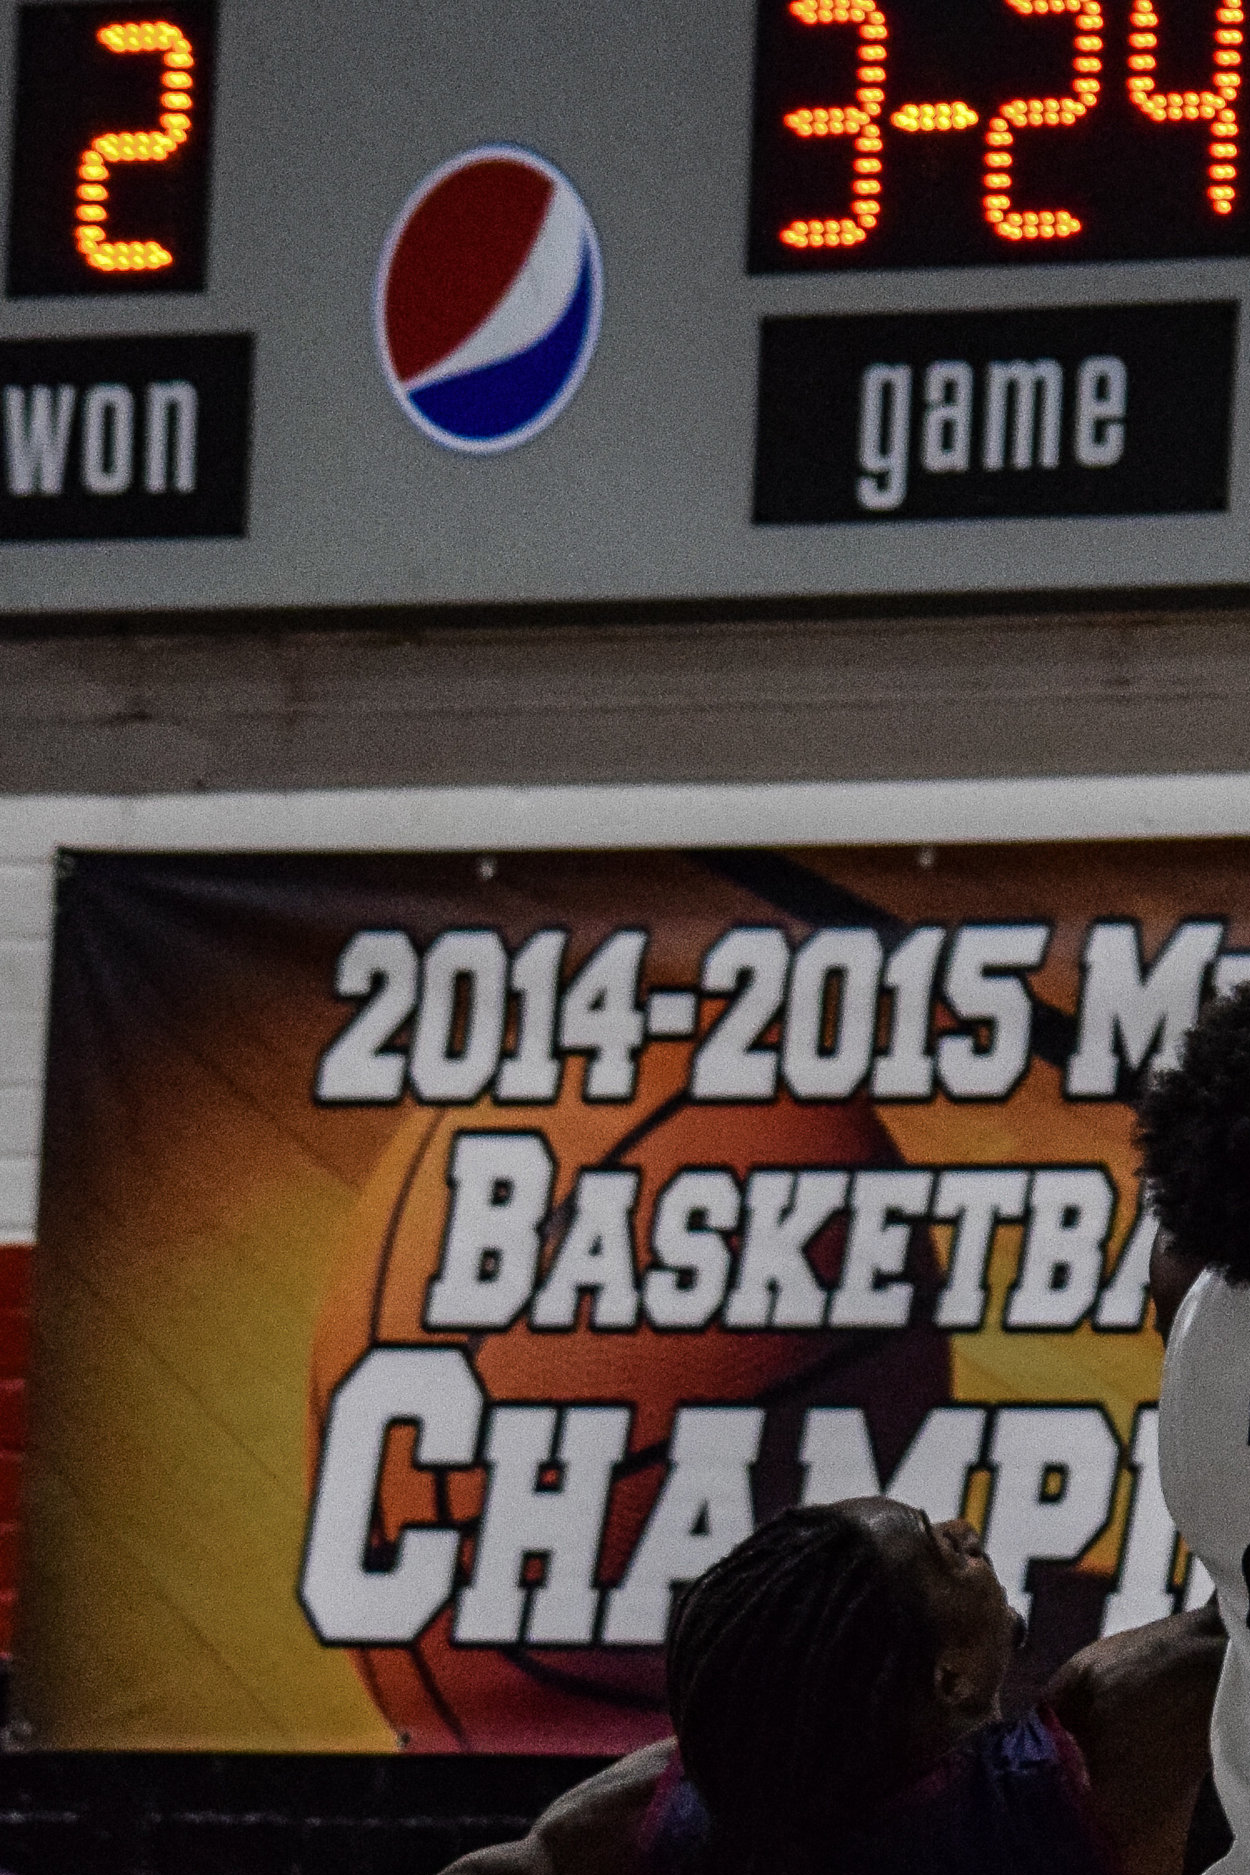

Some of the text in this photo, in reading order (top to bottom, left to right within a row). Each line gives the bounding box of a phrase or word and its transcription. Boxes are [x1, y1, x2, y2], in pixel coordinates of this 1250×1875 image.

[76, 21, 193, 272] 2
[0, 379, 200, 500] won
[854, 354, 1130, 511] game
[313, 923, 1053, 1105] 2014-2015
